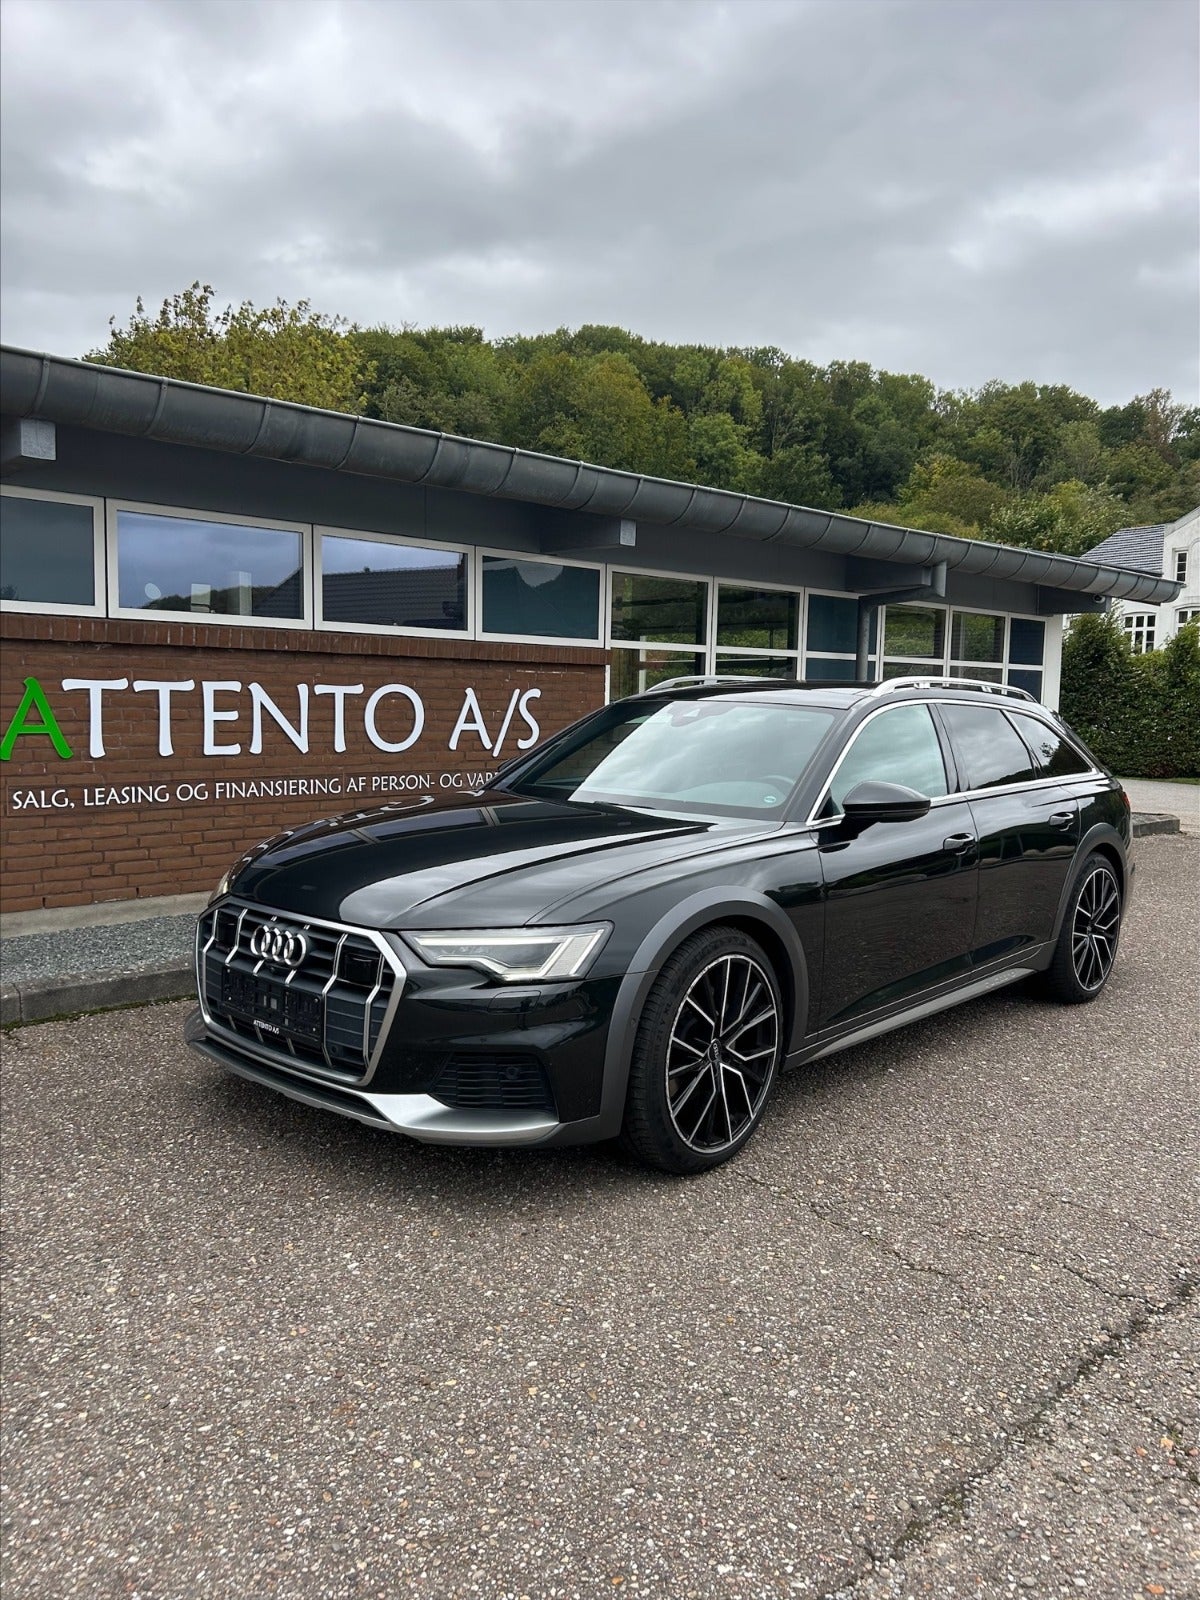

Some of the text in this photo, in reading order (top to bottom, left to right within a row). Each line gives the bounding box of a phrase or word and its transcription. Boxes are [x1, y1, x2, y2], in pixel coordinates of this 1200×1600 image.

[0, 676, 541, 761] ATTENTO A/S
[12, 772, 500, 809] SALG, LEASING OG FINANSIERING AF PERSON- OG VAR
